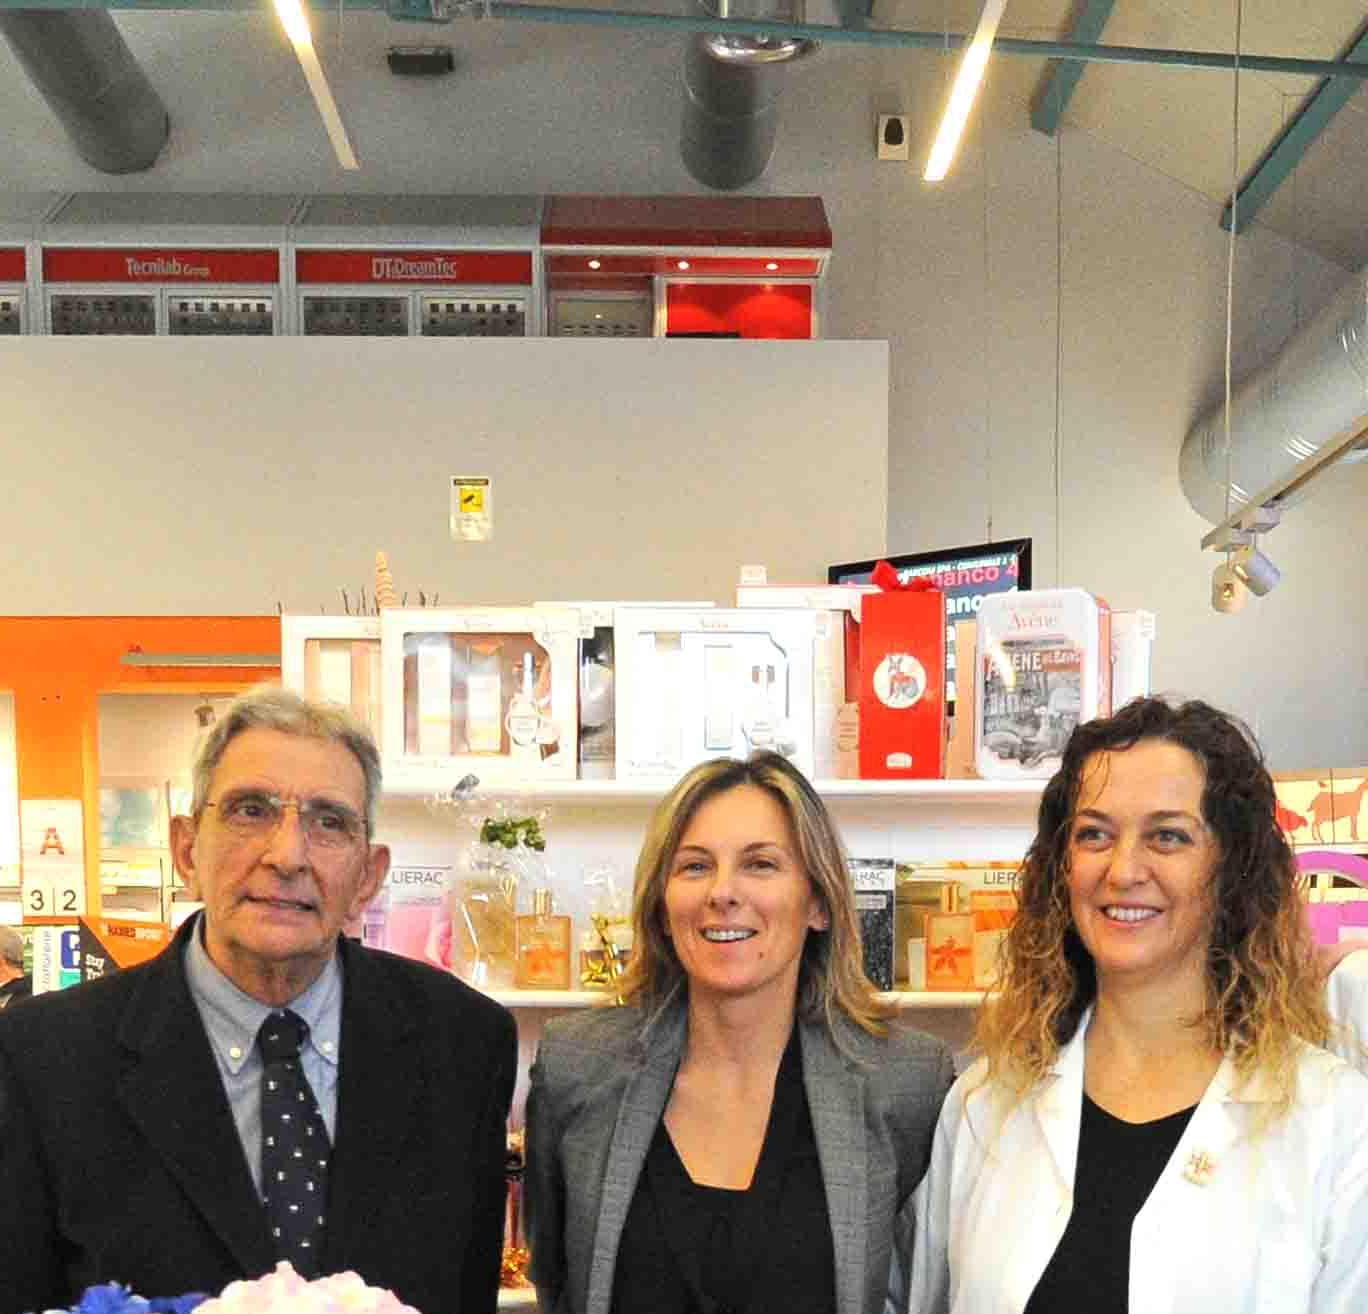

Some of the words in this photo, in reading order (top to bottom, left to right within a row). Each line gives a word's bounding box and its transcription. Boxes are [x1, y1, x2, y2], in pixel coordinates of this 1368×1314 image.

[40, 827, 65, 856] A
[391, 871, 444, 886] LIERAC
[31, 889, 45, 911] 3
[63, 889, 77, 911] 2
